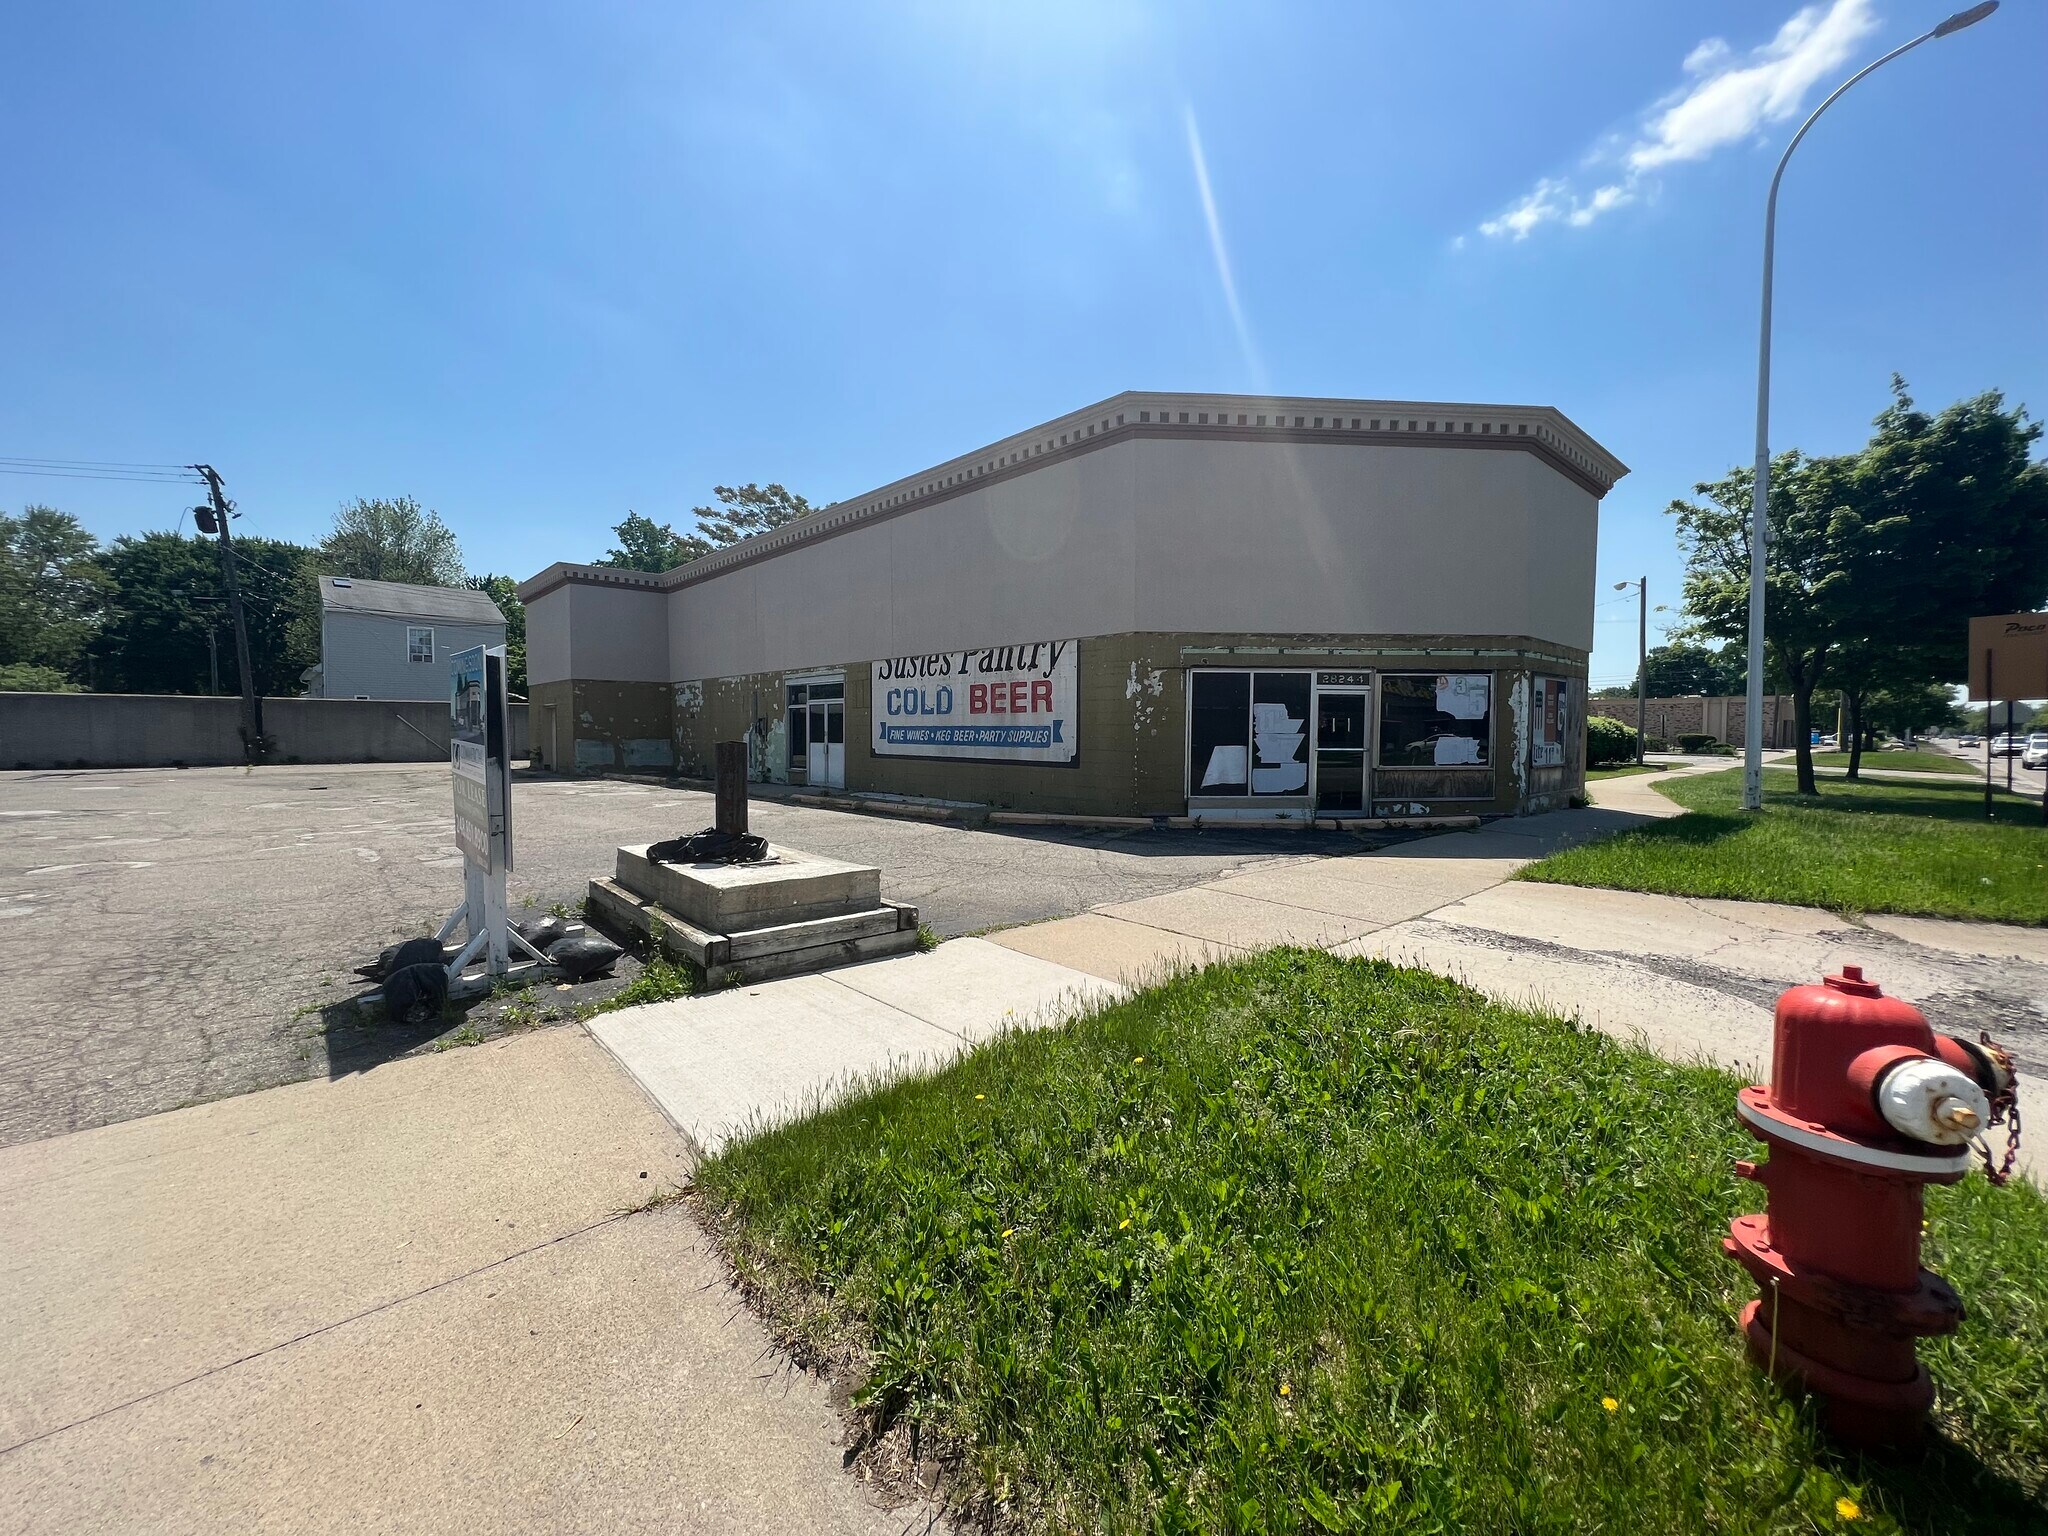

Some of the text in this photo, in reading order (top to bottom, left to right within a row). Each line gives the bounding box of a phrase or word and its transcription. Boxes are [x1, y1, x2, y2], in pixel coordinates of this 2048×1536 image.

[957, 641, 1067, 679] Pantry
[887, 679, 1054, 715] COLD BEER
[889, 729, 1049, 743] FINE WINES KEG BEER PARTY SUPPLIES
[467, 780, 486, 808] LEASE
